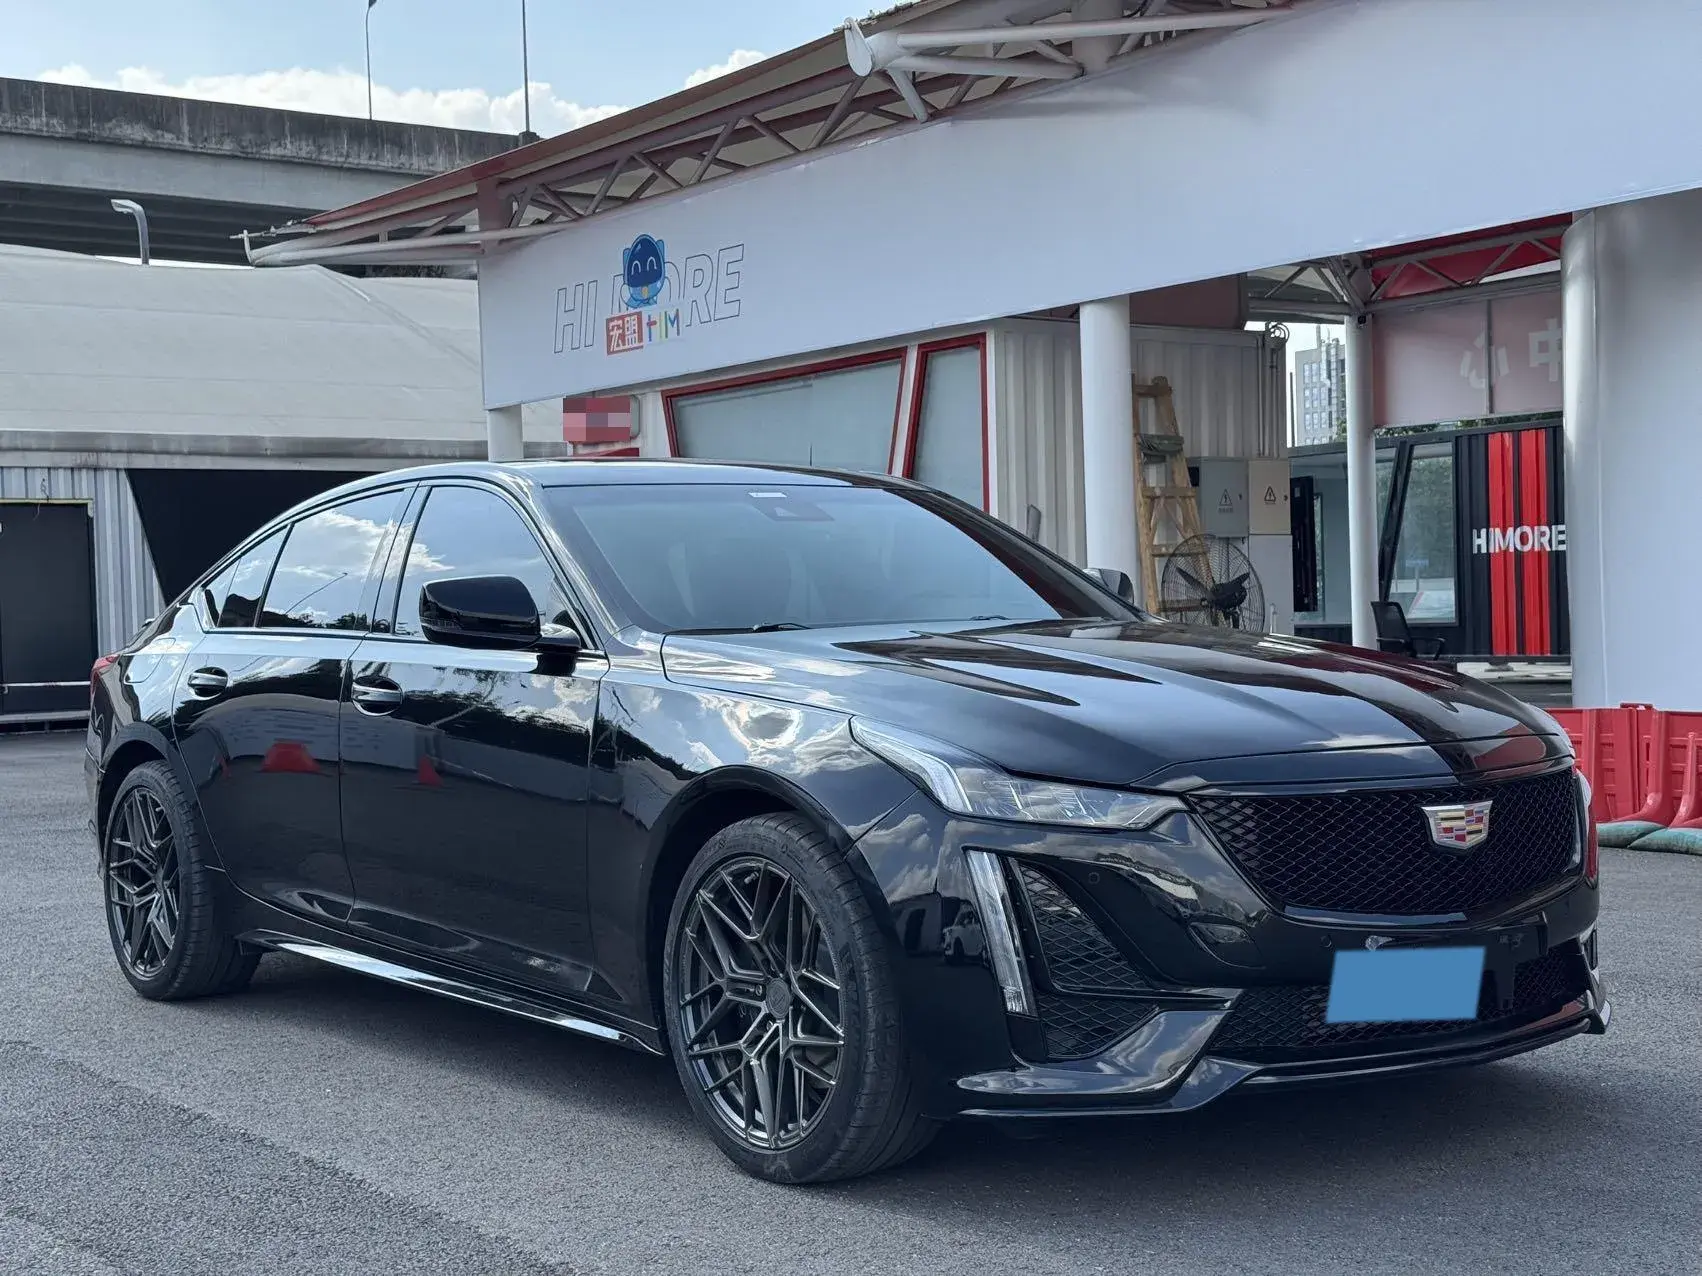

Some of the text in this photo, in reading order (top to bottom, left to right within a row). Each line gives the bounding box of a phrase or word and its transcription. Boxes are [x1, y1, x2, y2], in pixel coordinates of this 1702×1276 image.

[553, 280, 598, 354] HI
[609, 315, 643, 352] 宏盟
[1472, 525, 1567, 554] HIMORE
